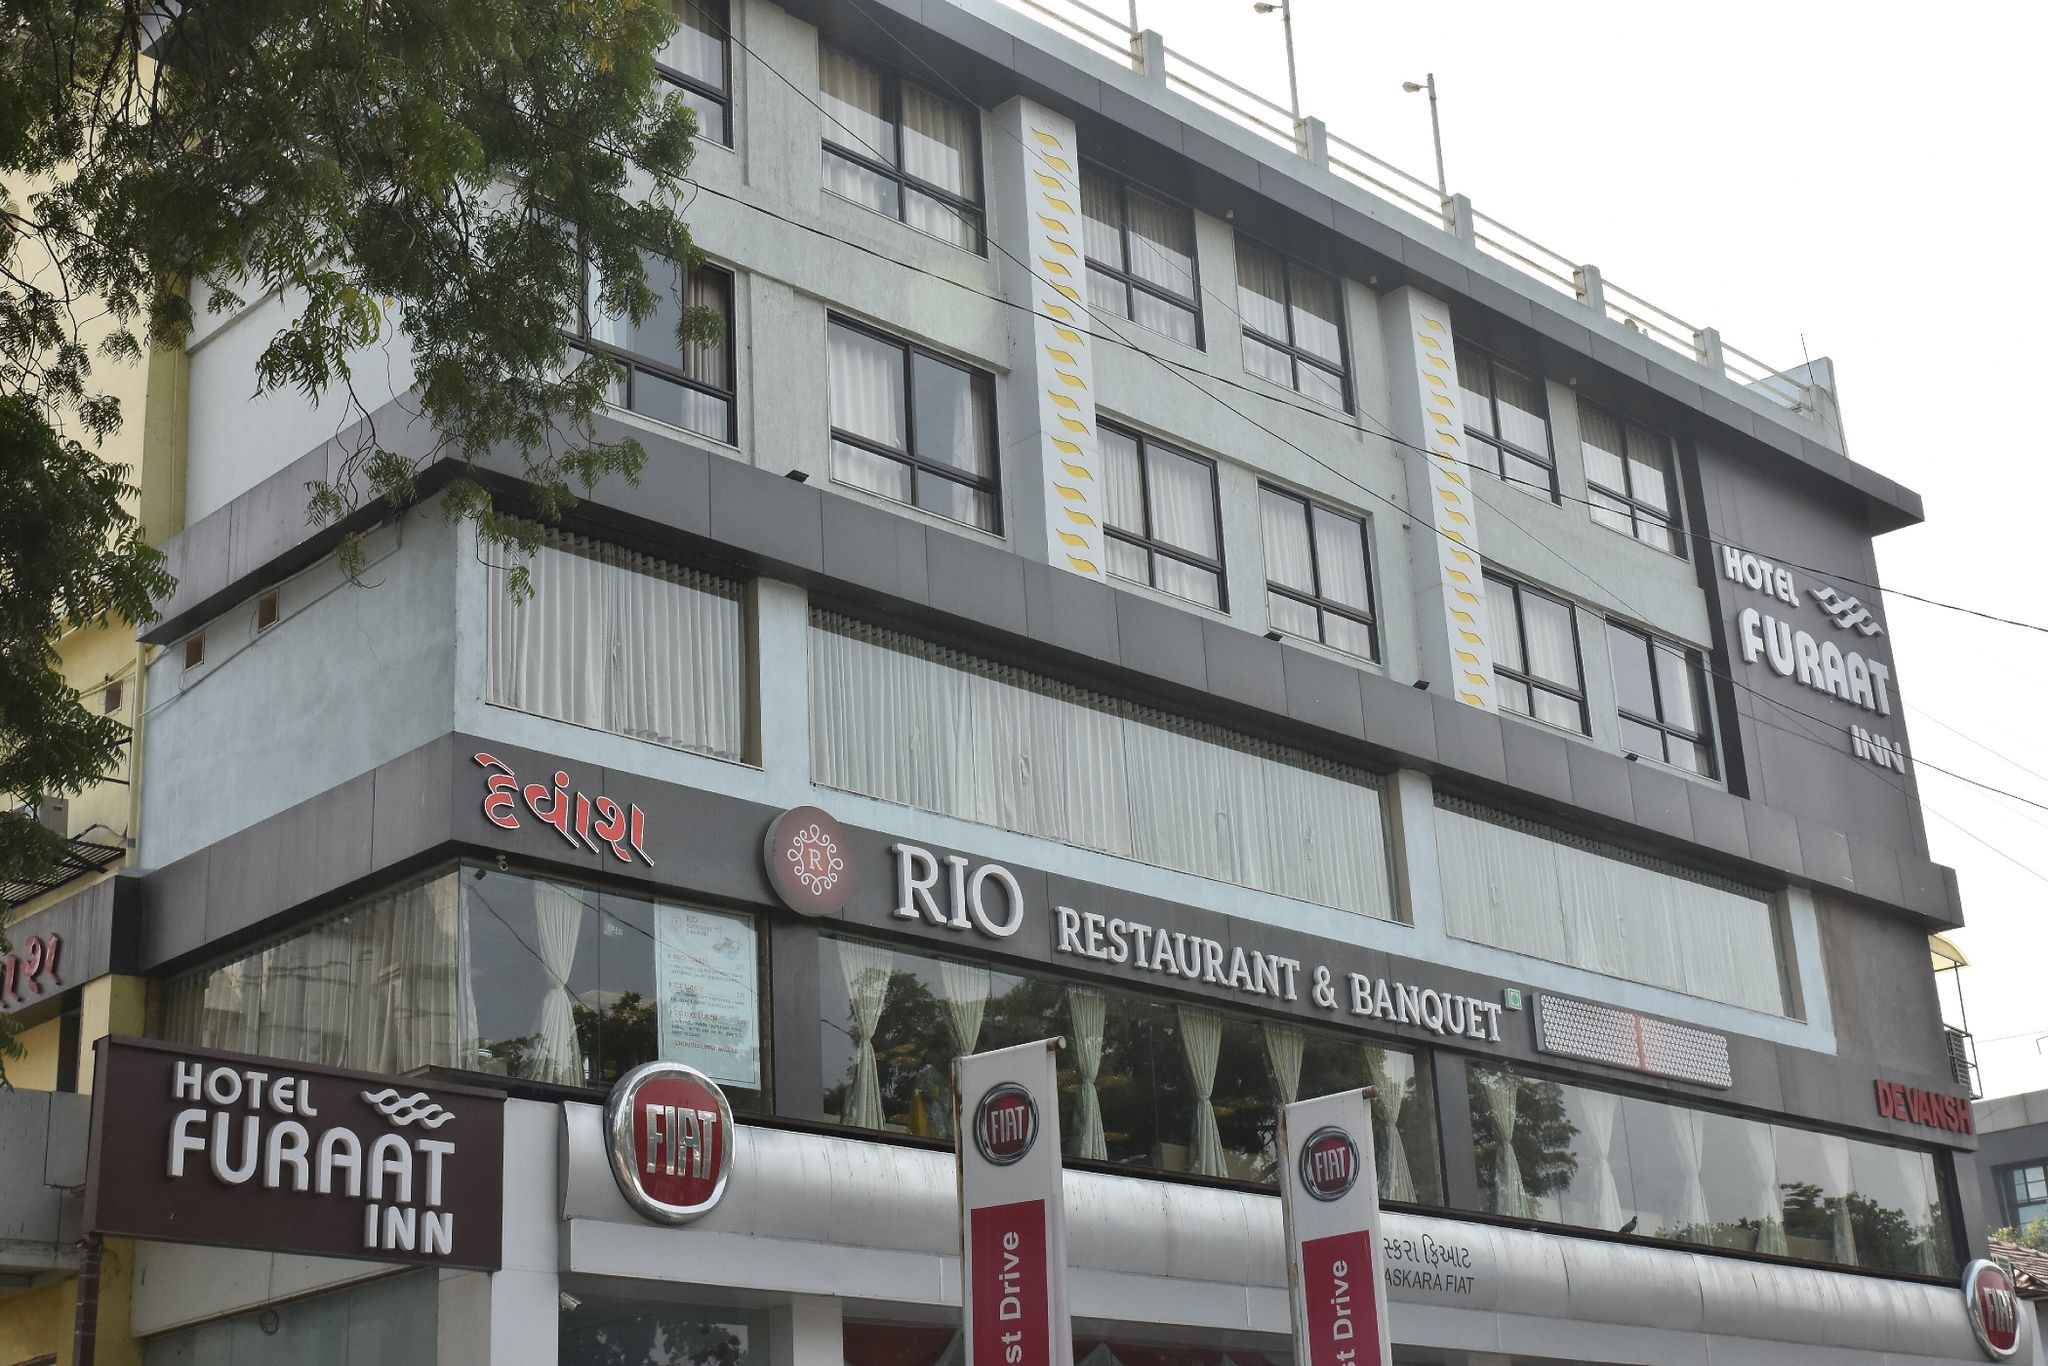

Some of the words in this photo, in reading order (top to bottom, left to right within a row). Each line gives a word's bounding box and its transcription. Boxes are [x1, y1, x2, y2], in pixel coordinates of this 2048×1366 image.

[1722, 545, 1799, 607] HOTEL
[1739, 608, 1890, 716] FURAAT
[1850, 724, 1905, 774] INN
[474, 753, 654, 867] દેવાંશ
[892, 842, 1024, 938] RIO
[1055, 905, 1300, 1001] RESTAURANT
[1312, 965, 1338, 1009] &
[1348, 972, 1502, 1042] BANQUET
[173, 1061, 318, 1117] HOTEL
[1874, 1080, 1972, 1134] DEVANSH
[646, 1104, 717, 1179] FIAT
[991, 1105, 1025, 1144] FIAT
[167, 1108, 455, 1206] FURAAT
[1315, 1147, 1345, 1183] FIAT
[364, 1203, 453, 1255] INN
[999, 1231, 1022, 1321] Drive
[1331, 1260, 1354, 1341] Drive
[1446, 1275, 1475, 1294] FIAT
